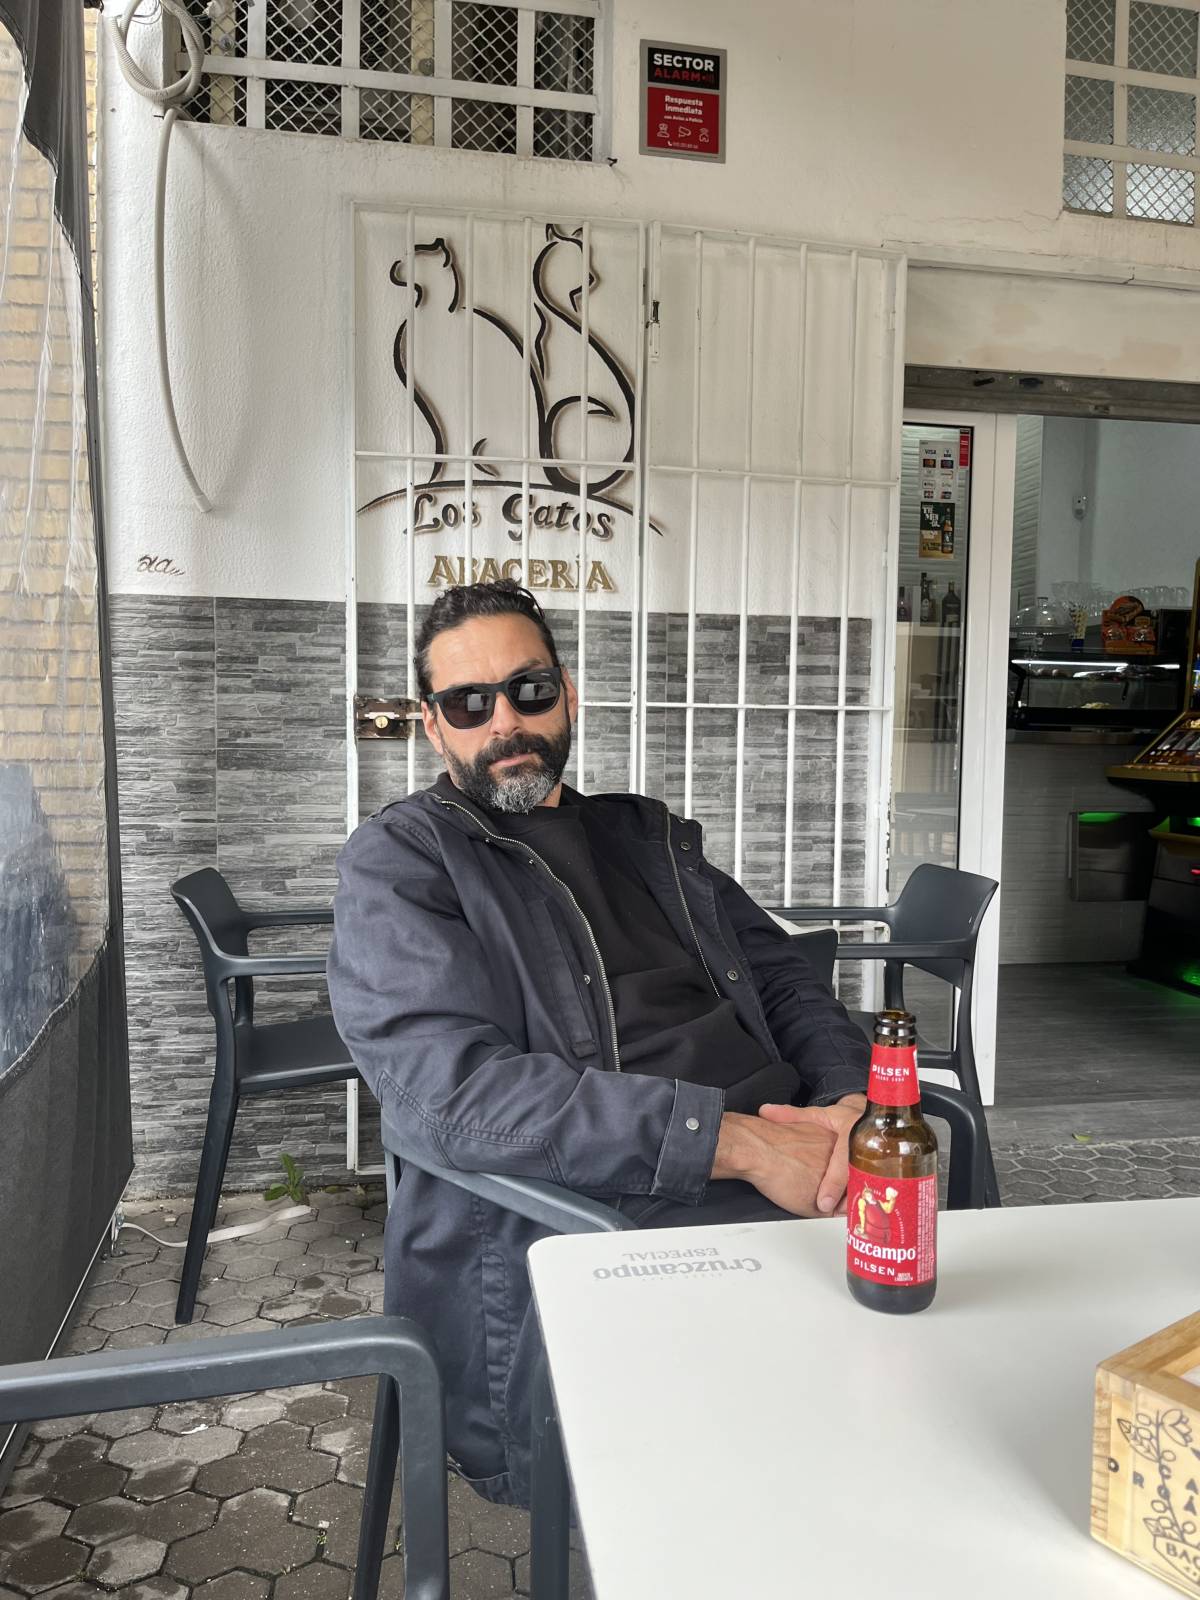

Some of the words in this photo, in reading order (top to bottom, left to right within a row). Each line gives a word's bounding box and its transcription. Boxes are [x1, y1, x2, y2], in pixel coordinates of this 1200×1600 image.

[653, 53, 714, 72] SECTOR
[654, 68, 700, 81] ALARM
[665, 95, 703, 106] Respuesta
[403, 493, 480, 535] Los
[502, 493, 612, 541] Gatos
[872, 1064, 910, 1077] PILSEN
[622, 1247, 720, 1262] ESPECIAL
[592, 1257, 762, 1280] Cruzcampo
[854, 1257, 895, 1276] PILSEN
